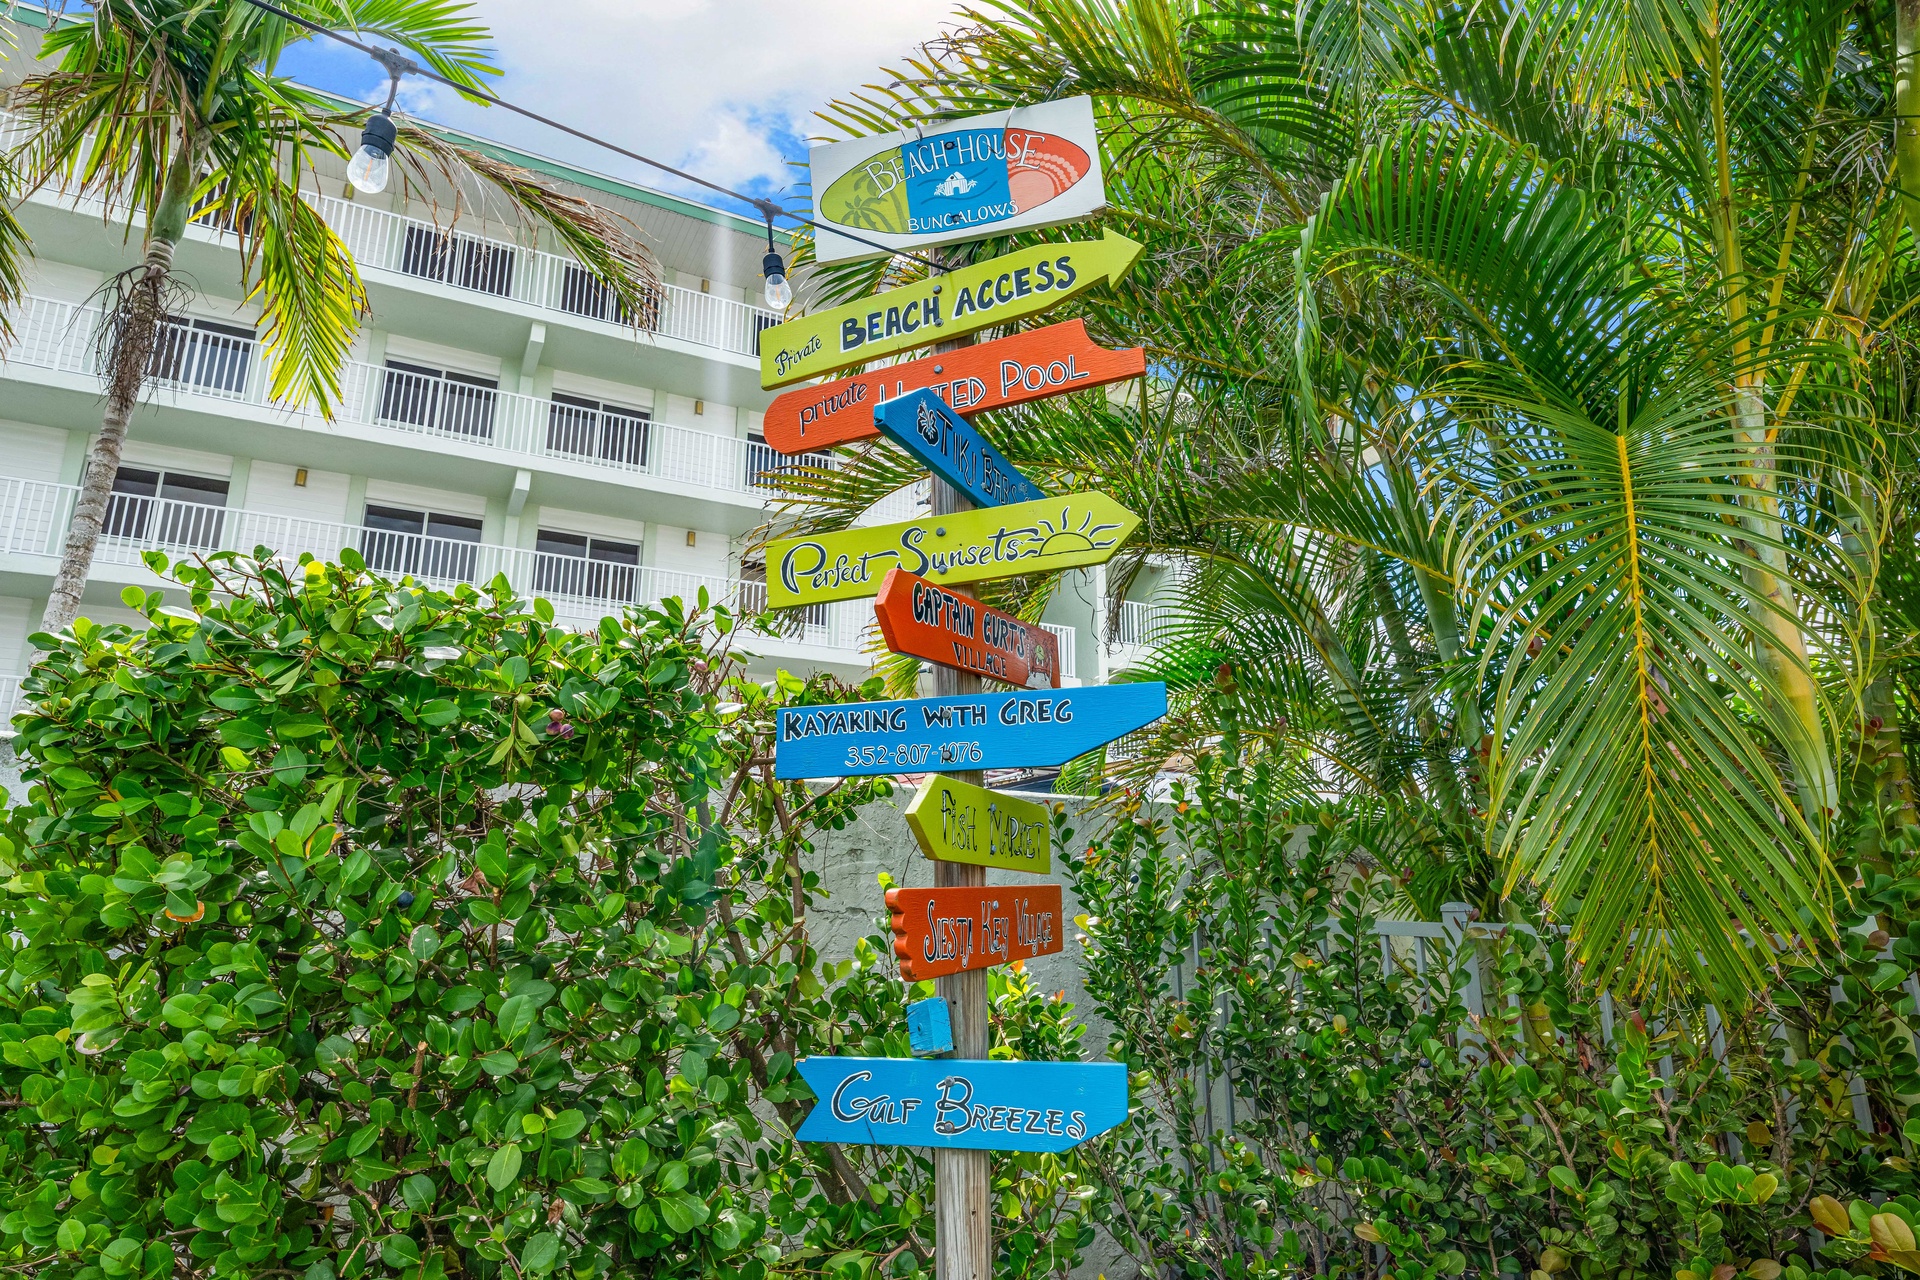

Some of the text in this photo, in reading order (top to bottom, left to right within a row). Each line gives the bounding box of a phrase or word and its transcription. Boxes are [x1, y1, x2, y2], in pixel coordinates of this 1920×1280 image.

[862, 132, 1046, 200] BEACH HOUSE
[908, 199, 1020, 232] BUNGALOWS
[774, 255, 1078, 377] Private BEACH ACCESS
[799, 354, 1090, 437] private TED POOL
[936, 408, 977, 488] TIKI
[780, 526, 1041, 595] Perfect Sunsets
[912, 581, 1027, 660] CAPTAIN CURT'S
[951, 641, 1008, 679] VILLAGE
[783, 697, 1074, 742] KAYAKING WITH GREG
[845, 741, 983, 767] 352-807-1076
[986, 803, 1045, 860] MARKET
[923, 897, 1054, 969] SIESTA KEY VILLAGE
[830, 1069, 1087, 1141] GULF BREEZES
